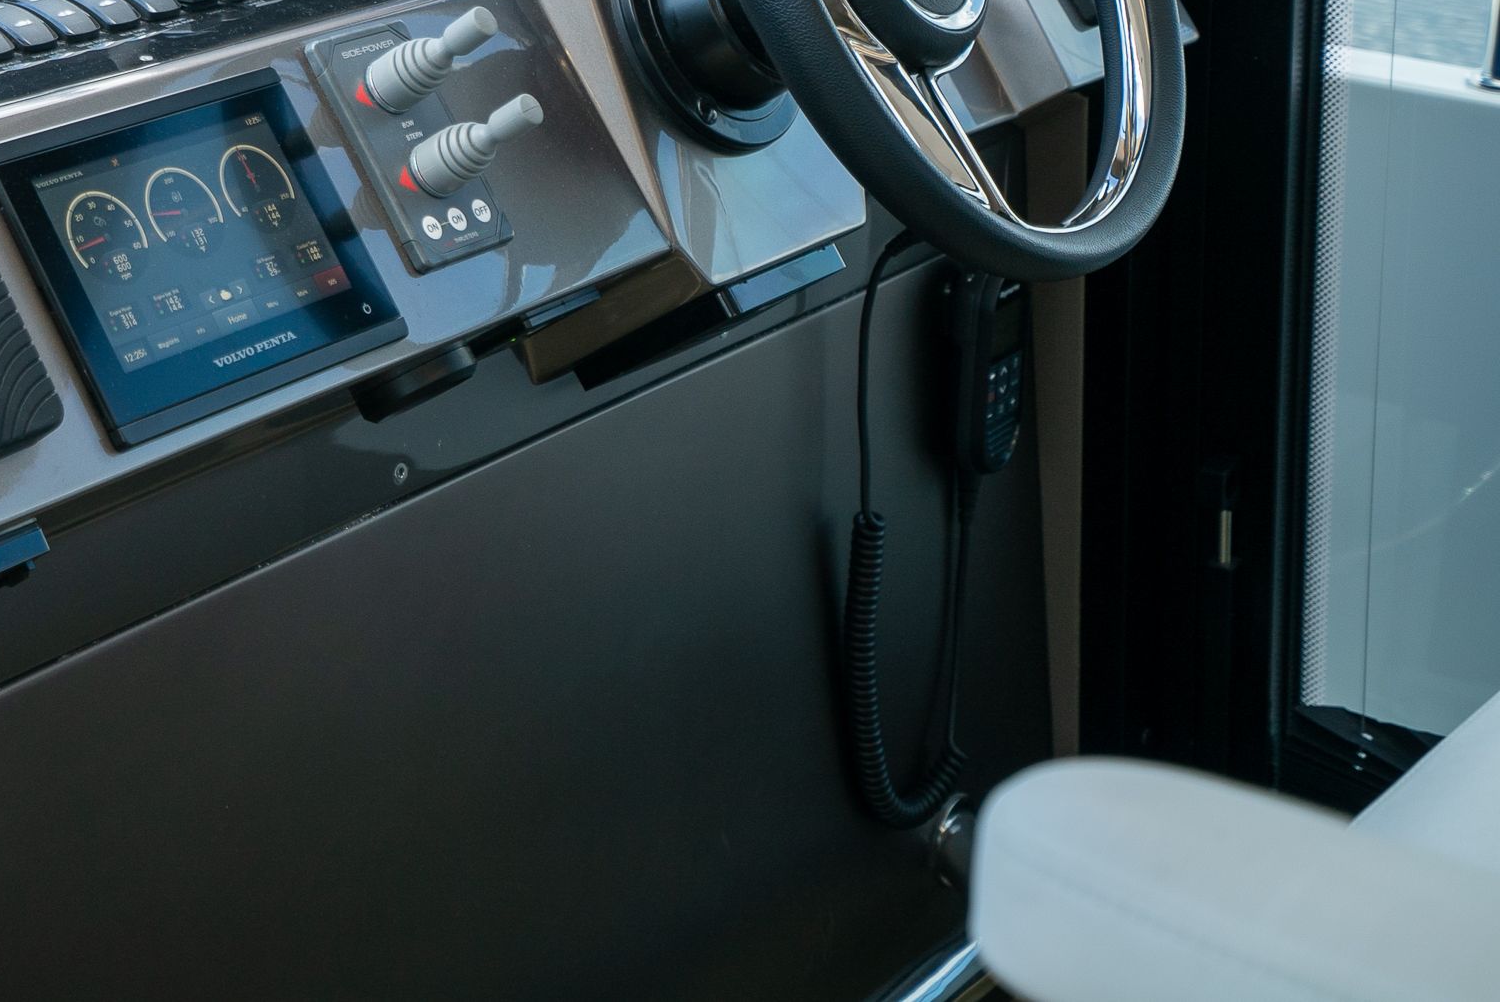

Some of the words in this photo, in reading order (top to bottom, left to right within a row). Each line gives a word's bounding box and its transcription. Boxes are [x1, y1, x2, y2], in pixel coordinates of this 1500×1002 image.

[402, 120, 414, 128] BOW
[406, 131, 424, 142] STERN
[36, 178, 58, 189] VOLVO
[59, 170, 84, 182] PENTA
[87, 202, 96, 210] 30
[107, 204, 116, 212] 40
[474, 206, 488, 216] OFF
[76, 214, 84, 222] 20
[452, 214, 464, 224] ON
[124, 220, 133, 228] 50
[426, 222, 440, 232] ON
[76, 235, 85, 244] 10
[133, 242, 142, 250] 60
[90, 256, 96, 264] 0
[112, 254, 128, 264] 600
[116, 262, 132, 273] 600
[227, 312, 248, 325] Home
[213, 346, 254, 368] VOLVO
[254, 331, 298, 352] PENTA
